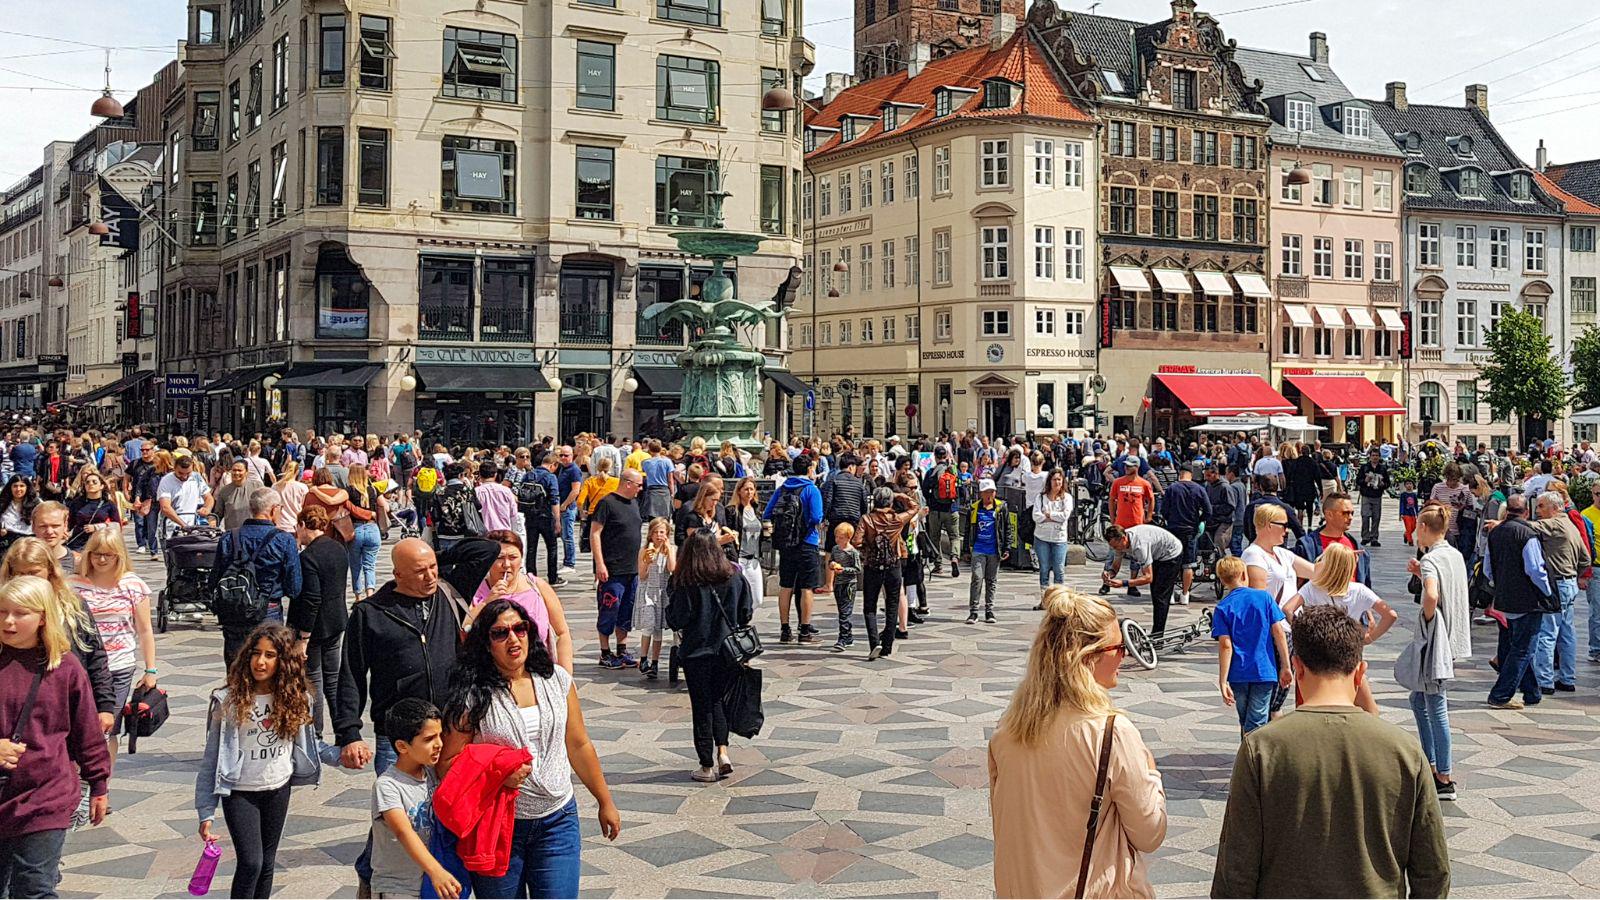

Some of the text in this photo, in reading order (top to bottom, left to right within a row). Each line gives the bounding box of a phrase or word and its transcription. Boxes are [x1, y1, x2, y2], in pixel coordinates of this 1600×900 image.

[102, 206, 121, 246] HAY
[471, 350, 515, 362] NORDEN
[922, 350, 965, 359] ESPRESSO HOUSE
[1026, 349, 1096, 358] ESPRESSO HOUSE
[168, 377, 196, 385] MONEY
